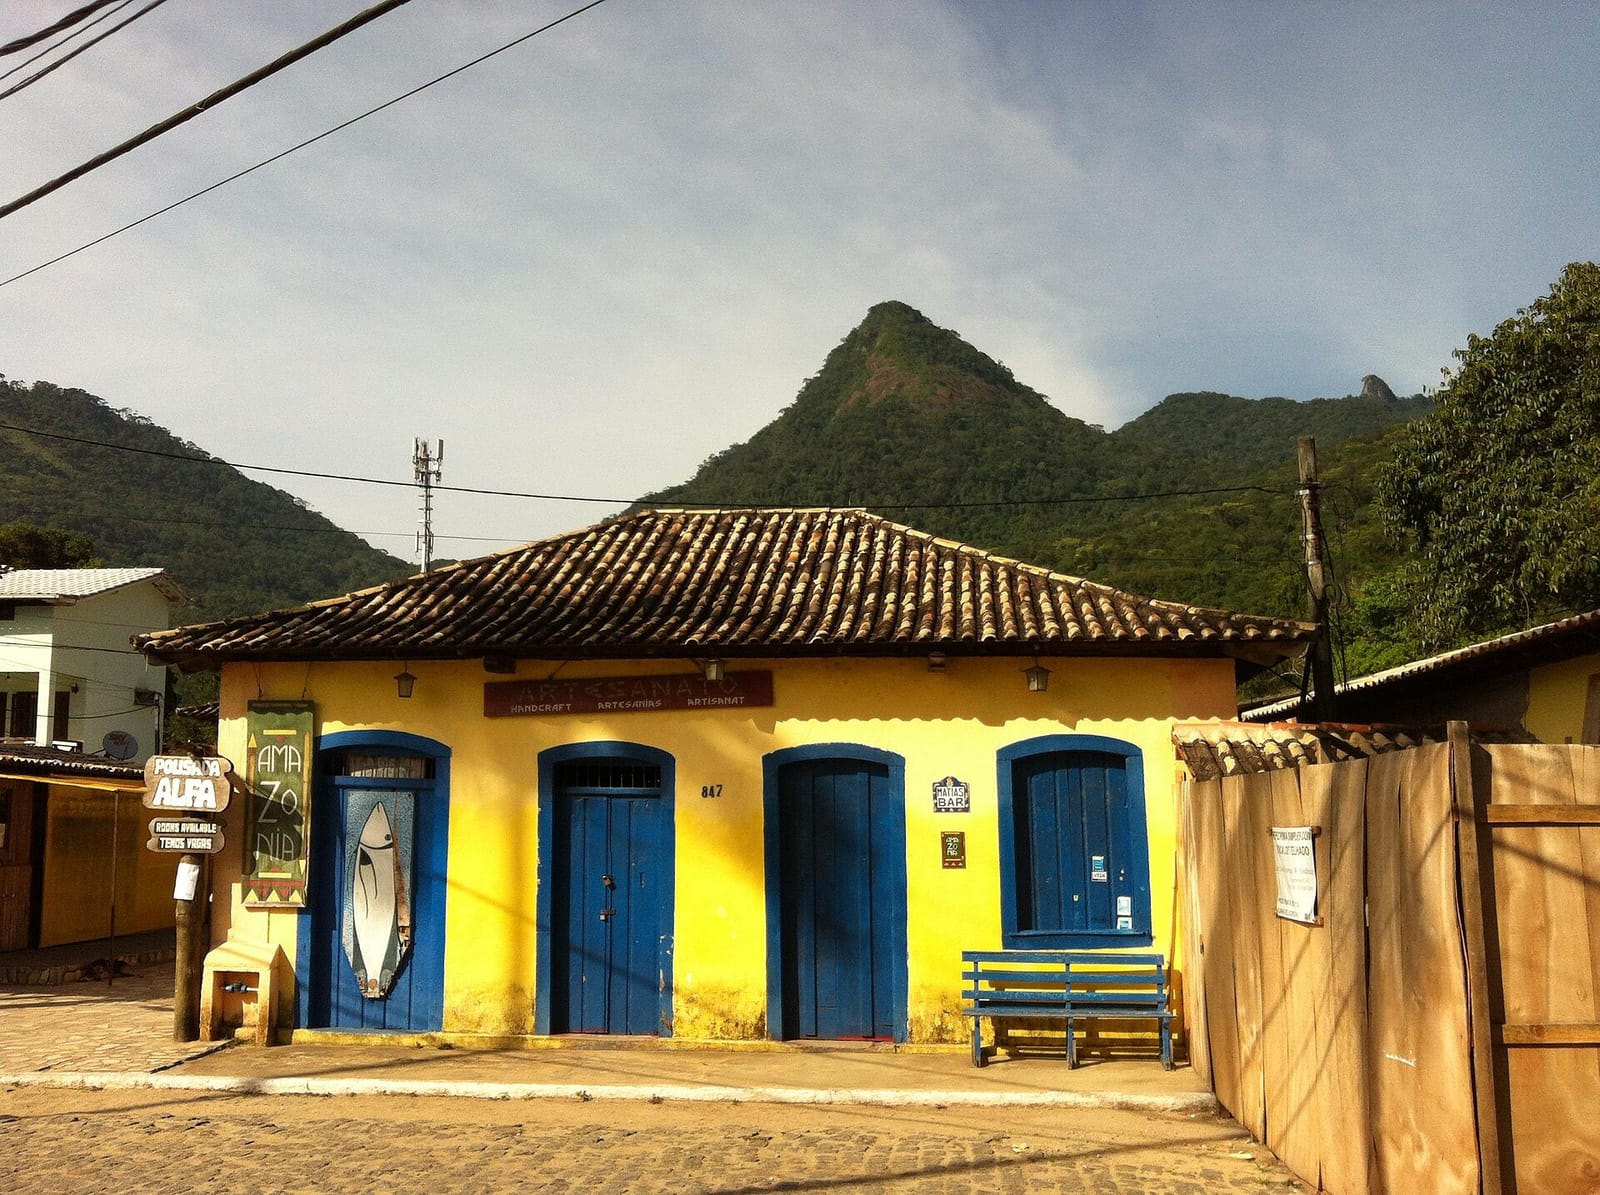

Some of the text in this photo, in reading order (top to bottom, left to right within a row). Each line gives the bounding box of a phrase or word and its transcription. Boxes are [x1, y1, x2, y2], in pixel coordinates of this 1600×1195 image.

[518, 675, 739, 702] ARTESANATO
[511, 703, 572, 713] HANDCRAFT
[257, 744, 301, 773] AMA
[154, 758, 220, 778] POUSADA
[152, 776, 217, 808] ALFA
[701, 784, 723, 798] 847
[936, 787, 964, 797] MATIAS
[257, 780, 298, 823] ZO
[938, 797, 964, 807] BAR
[155, 822, 217, 834] ROOMS AVAILABLE
[159, 837, 212, 850] TEMOS VAGAS
